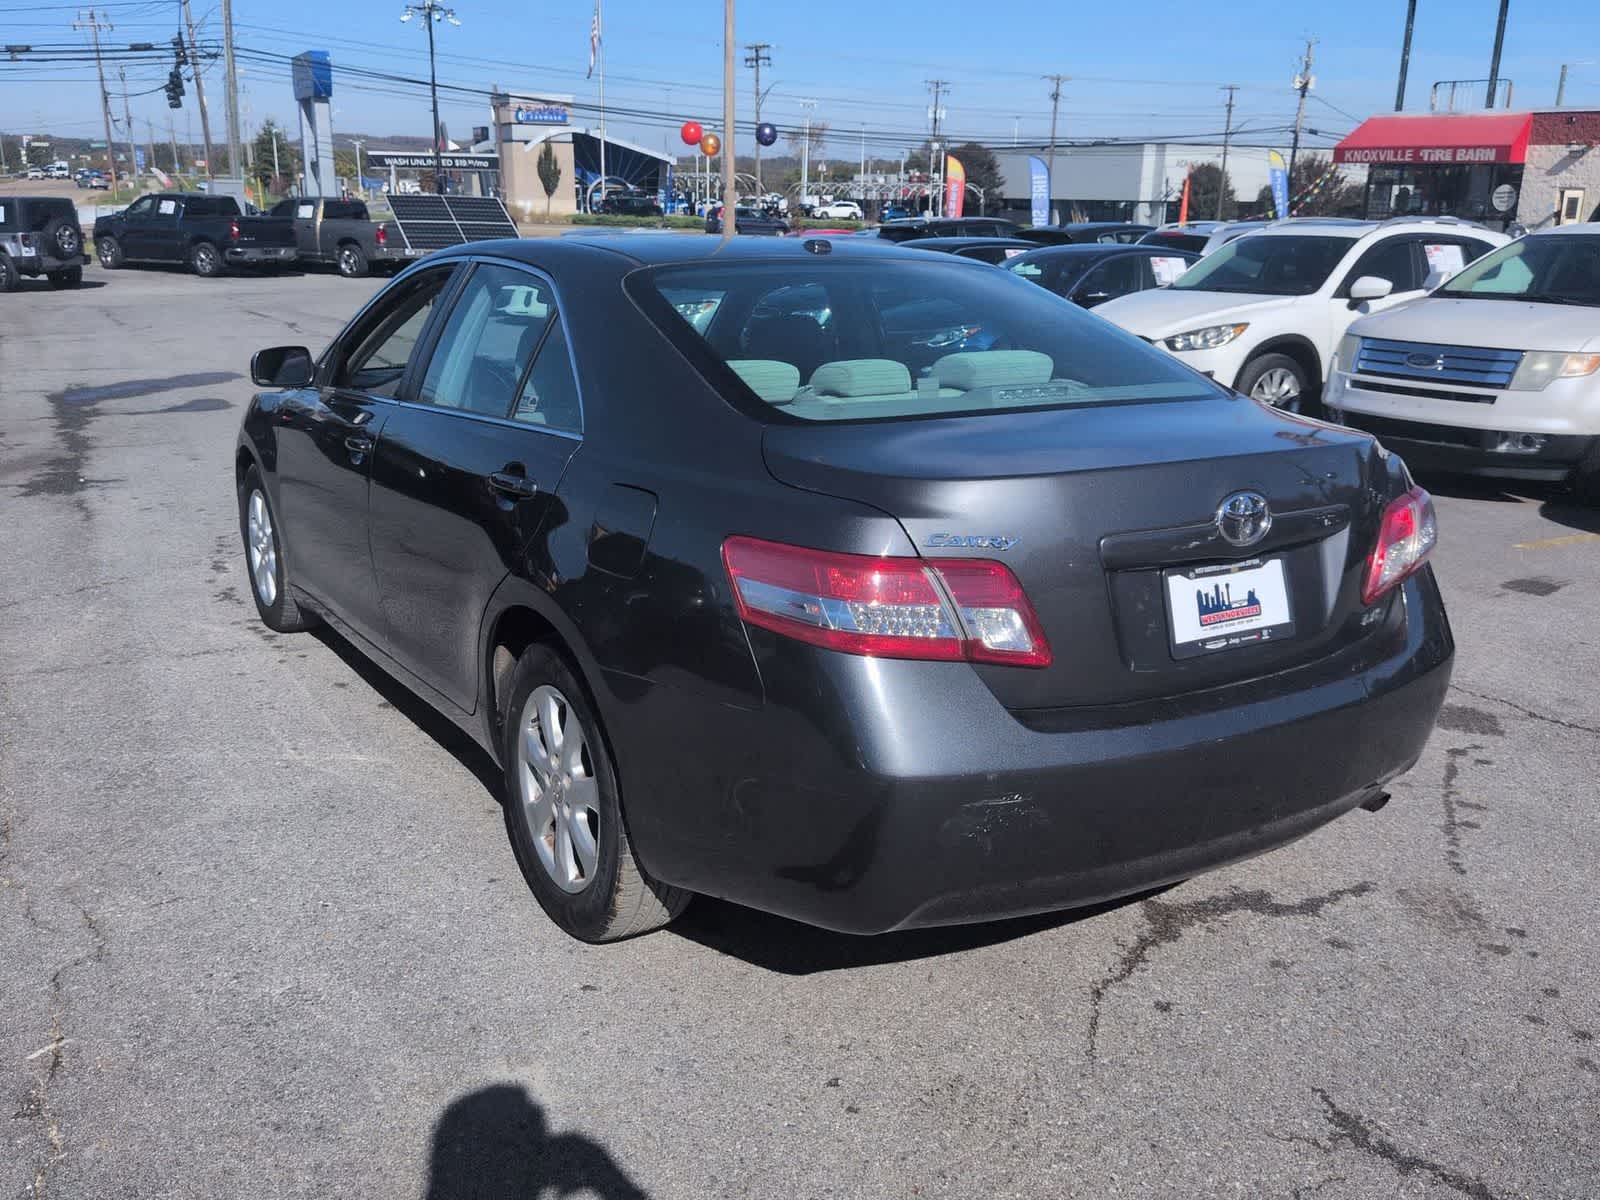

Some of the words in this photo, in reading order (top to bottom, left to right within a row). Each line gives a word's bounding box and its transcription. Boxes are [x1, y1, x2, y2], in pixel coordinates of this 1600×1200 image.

[1343, 149, 1413, 162] KNOXVILLE
[1419, 148, 1452, 162] TIRE
[1455, 148, 1496, 161] BARN
[384, 157, 409, 166] WASH
[410, 158, 453, 167] UNLIMIED
